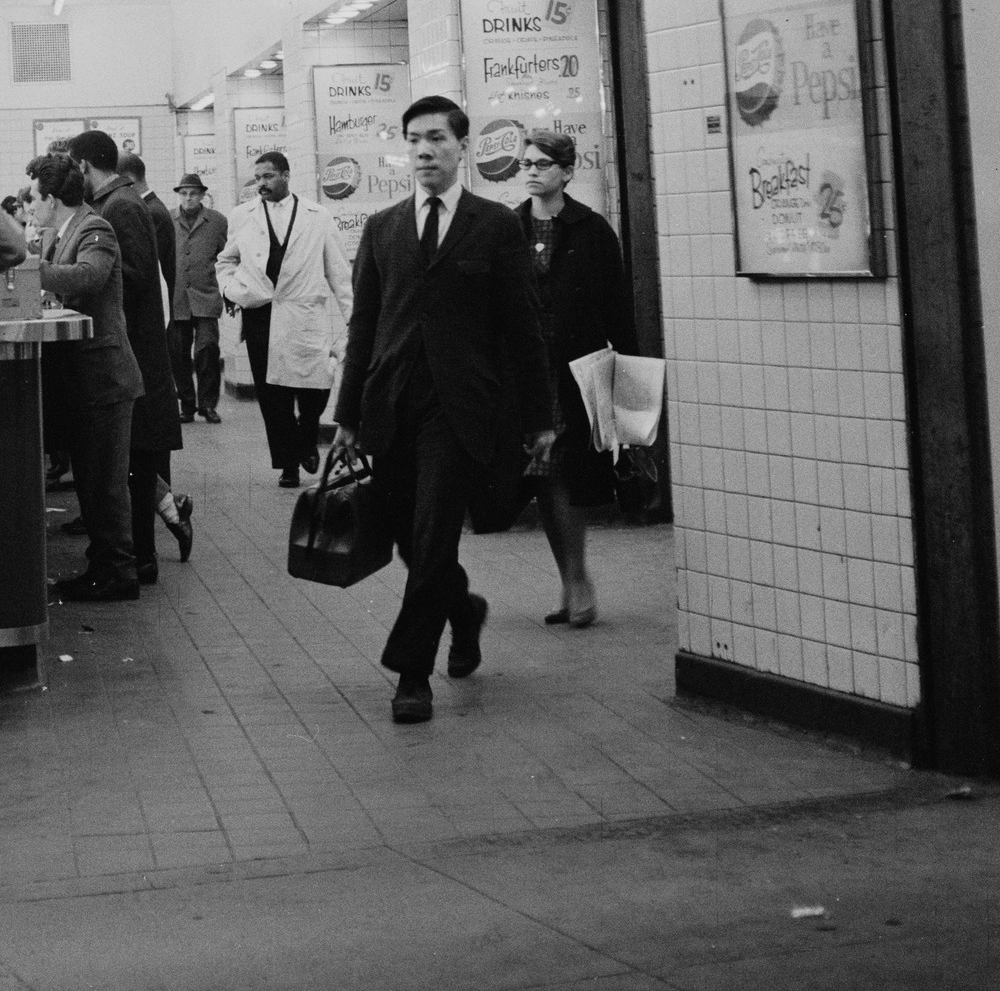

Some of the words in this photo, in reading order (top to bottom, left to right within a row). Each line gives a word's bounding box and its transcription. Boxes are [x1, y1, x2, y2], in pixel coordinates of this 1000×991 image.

[482, 16, 542, 34] DRINKS
[484, 54, 560, 83] Frankfurters
[329, 85, 372, 98] DRINKS
[791, 55, 859, 120] Pepsi
[246, 123, 279, 133] DRINKS
[328, 112, 377, 136] Hamburger
[553, 119, 587, 135] Have
[368, 174, 412, 199] Pepsi
[748, 152, 811, 210] Breakfast
